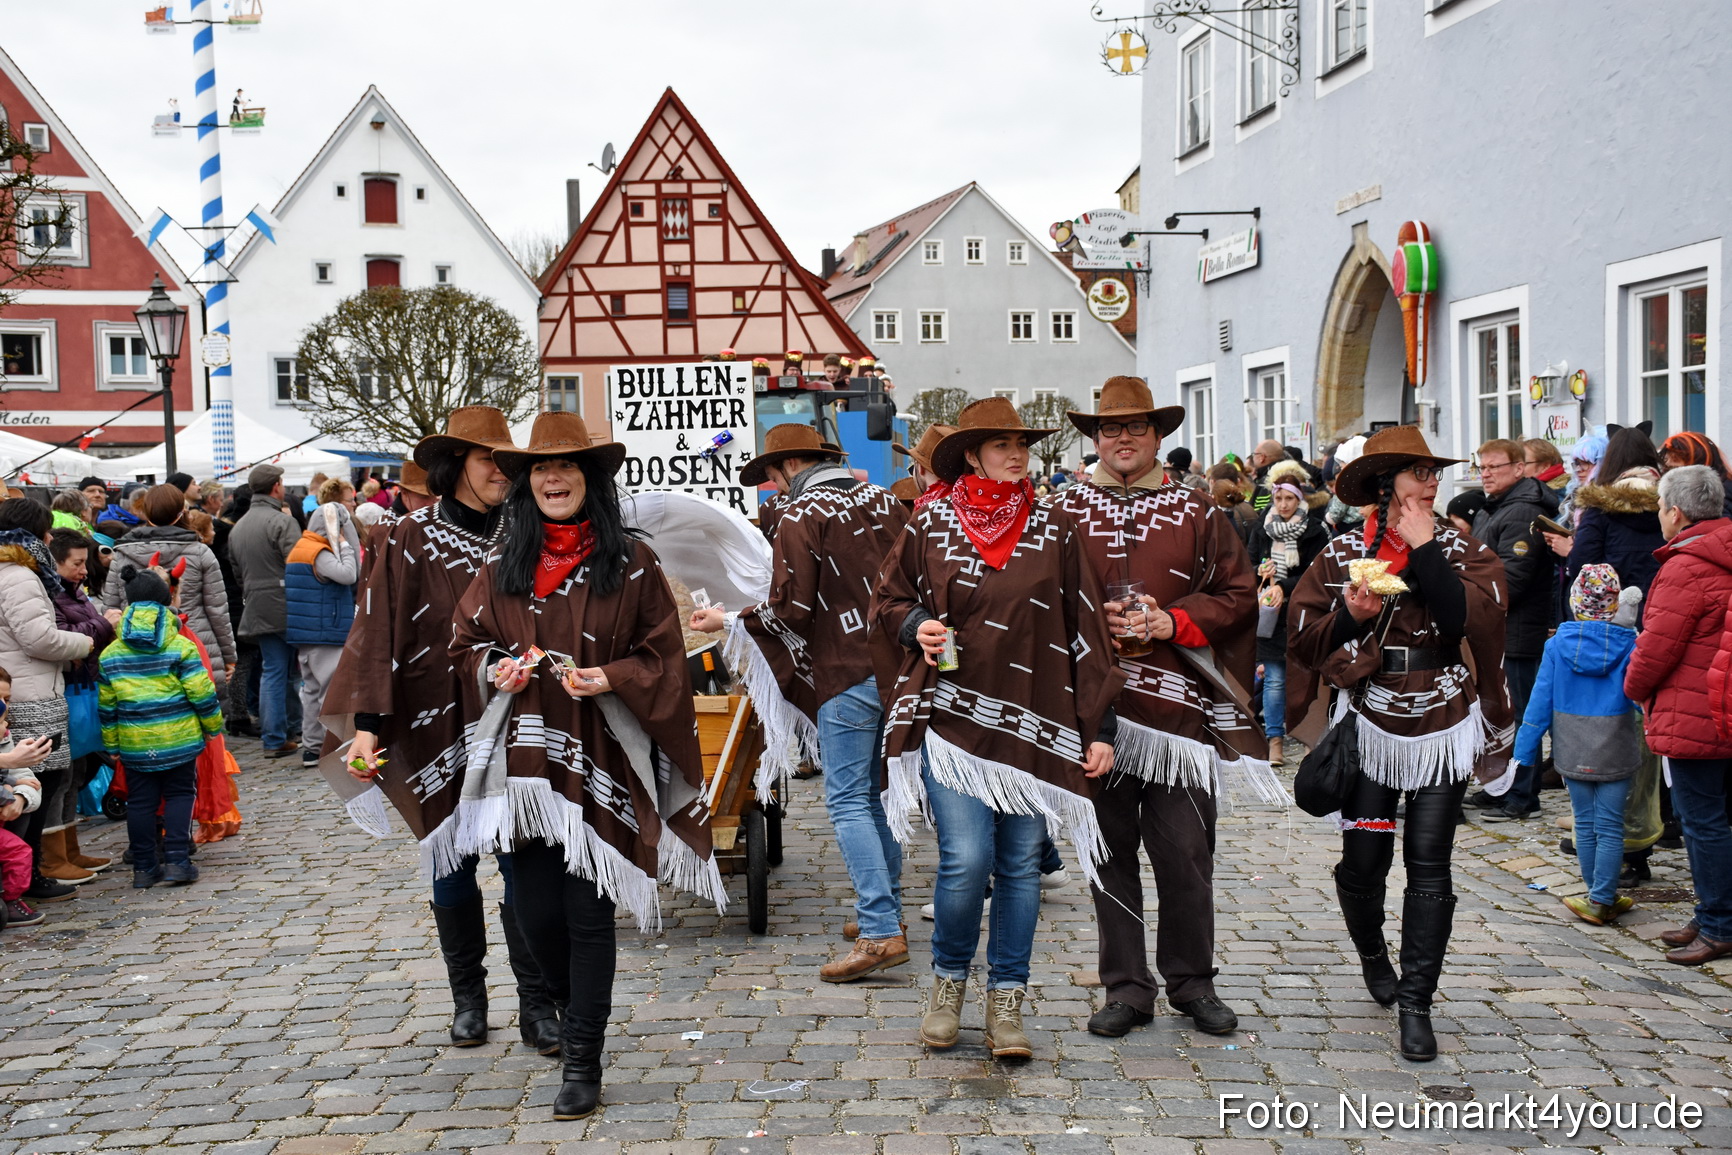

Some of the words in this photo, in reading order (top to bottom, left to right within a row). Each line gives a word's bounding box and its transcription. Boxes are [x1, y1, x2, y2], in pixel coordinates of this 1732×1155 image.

[1089, 211, 1126, 220] Pizzeria
[1089, 235, 1120, 246] Eisdie
[1208, 255, 1225, 275] Bella
[1226, 252, 1246, 269] Roma
[617, 365, 747, 398] BULLEN-
[625, 398, 748, 431] ZÄHMER
[1554, 415, 1569, 430] Eis
[676, 433, 690, 451] &
[625, 454, 743, 487] DOSEN-
